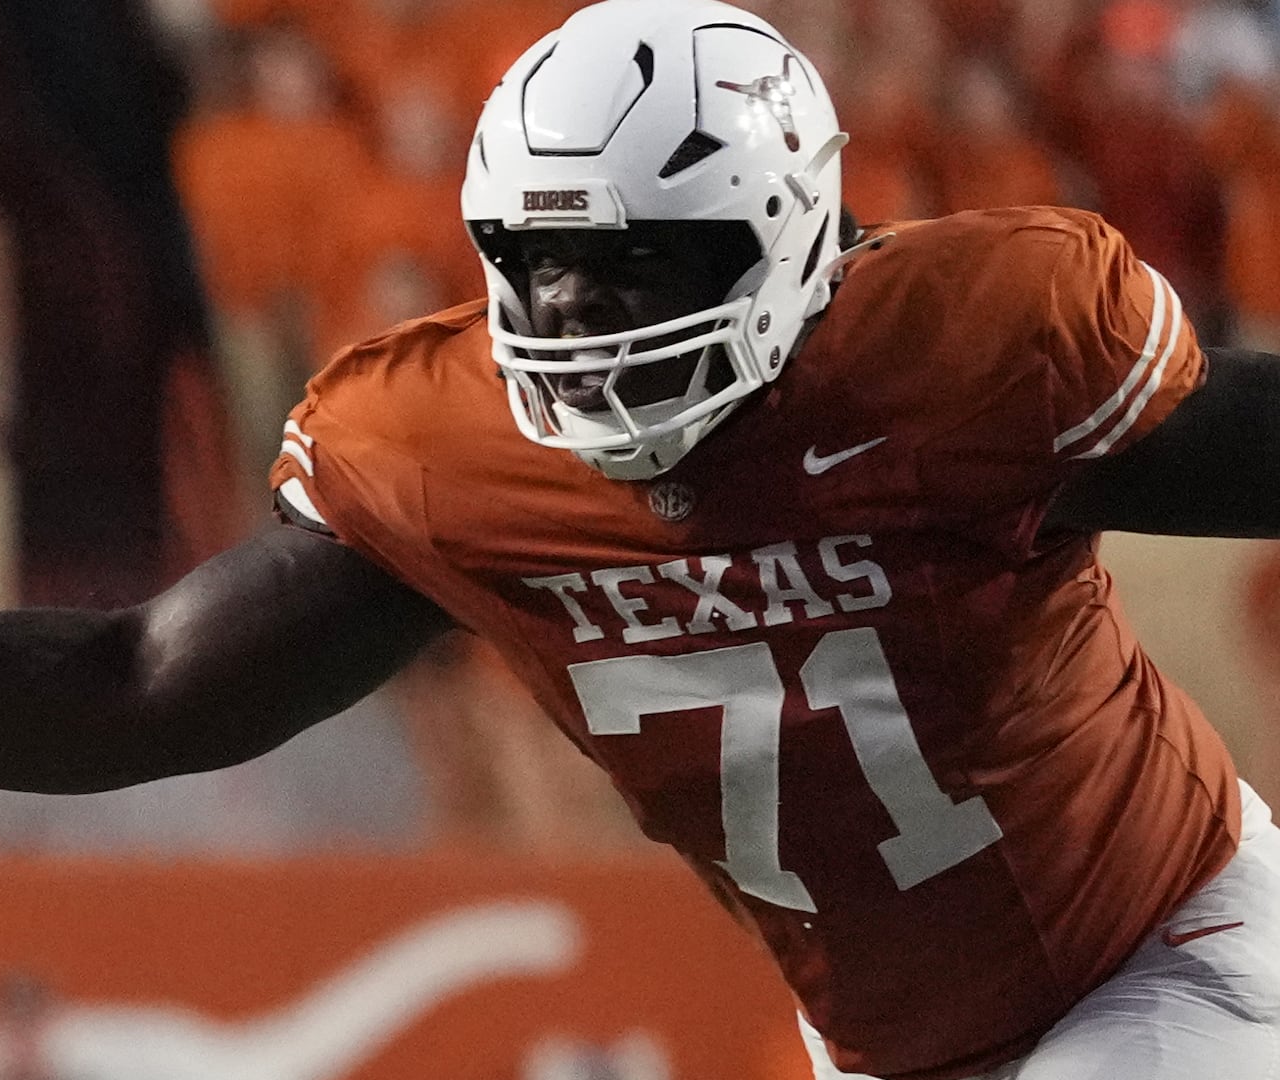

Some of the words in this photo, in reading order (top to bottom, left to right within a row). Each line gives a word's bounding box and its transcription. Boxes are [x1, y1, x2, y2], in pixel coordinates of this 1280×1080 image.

[522, 190, 588, 211] HORNS
[522, 534, 892, 644] TEXAS
[567, 626, 1004, 914] 71
